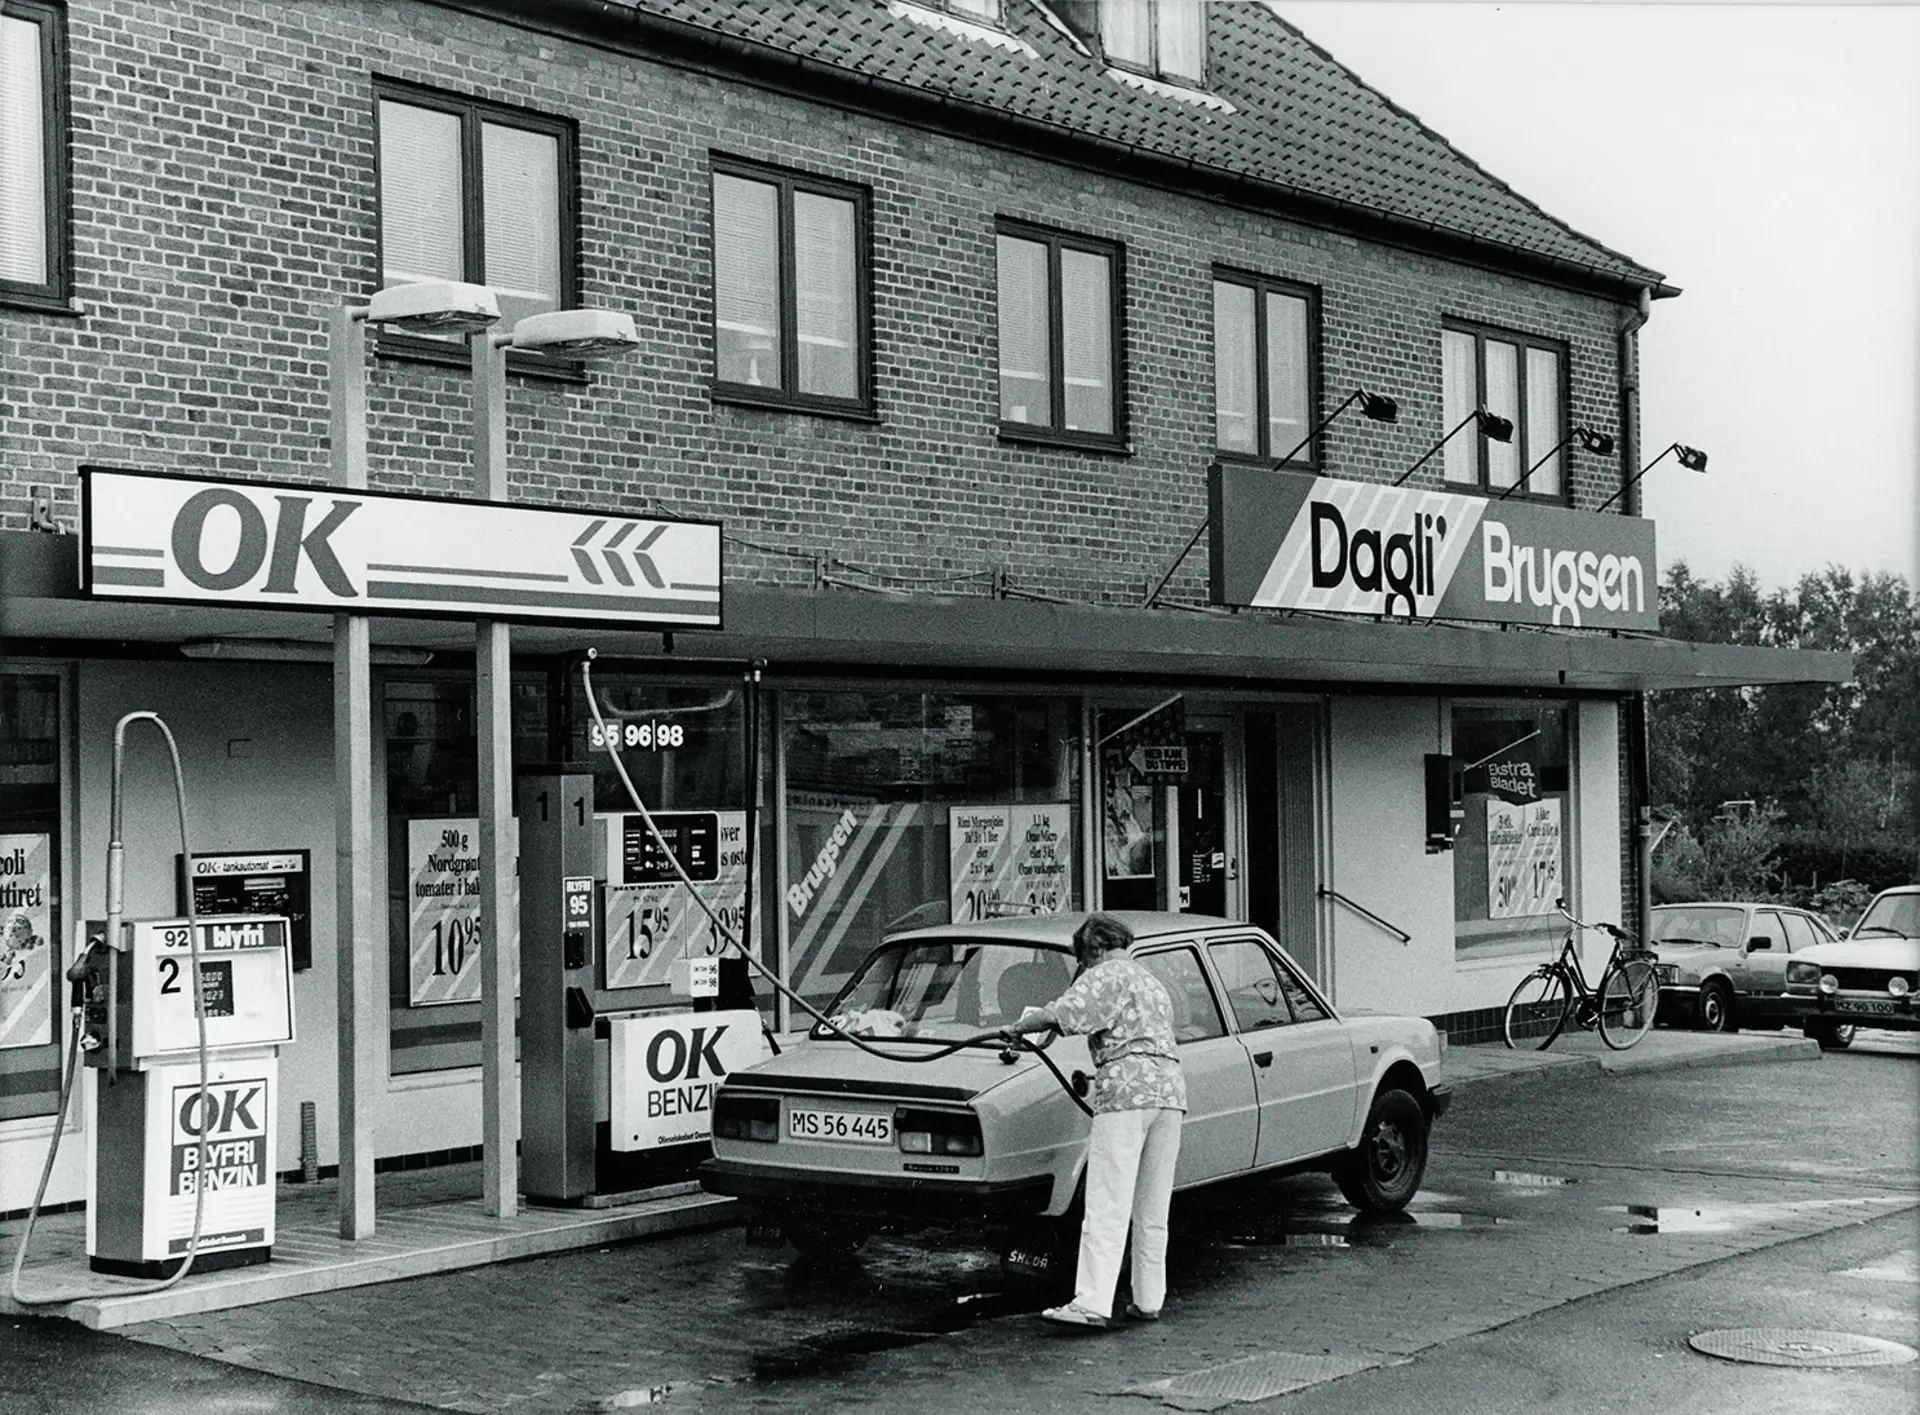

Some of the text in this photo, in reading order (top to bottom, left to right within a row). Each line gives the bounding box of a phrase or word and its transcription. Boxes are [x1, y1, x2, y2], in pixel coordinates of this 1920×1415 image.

[171, 487, 363, 598] OK
[1310, 500, 1645, 627] Dagli' Brugsen
[592, 724, 684, 747] 95 96 98
[1488, 760, 1534, 777] Ekstra
[1490, 777, 1537, 798] Bladet
[536, 791, 548, 822] 1
[573, 796, 584, 826] 1
[441, 829, 469, 852] 500 g
[787, 809, 858, 918] Brugsen
[415, 880, 455, 897] tomater
[569, 895, 588, 915] 95
[164, 923, 264, 950] 92 blyfri
[159, 958, 181, 994] 2
[646, 1025, 730, 1083] OK
[179, 1086, 262, 1136] OK
[648, 1082, 718, 1118] BENZI
[792, 1112, 889, 1139] MS 56 445
